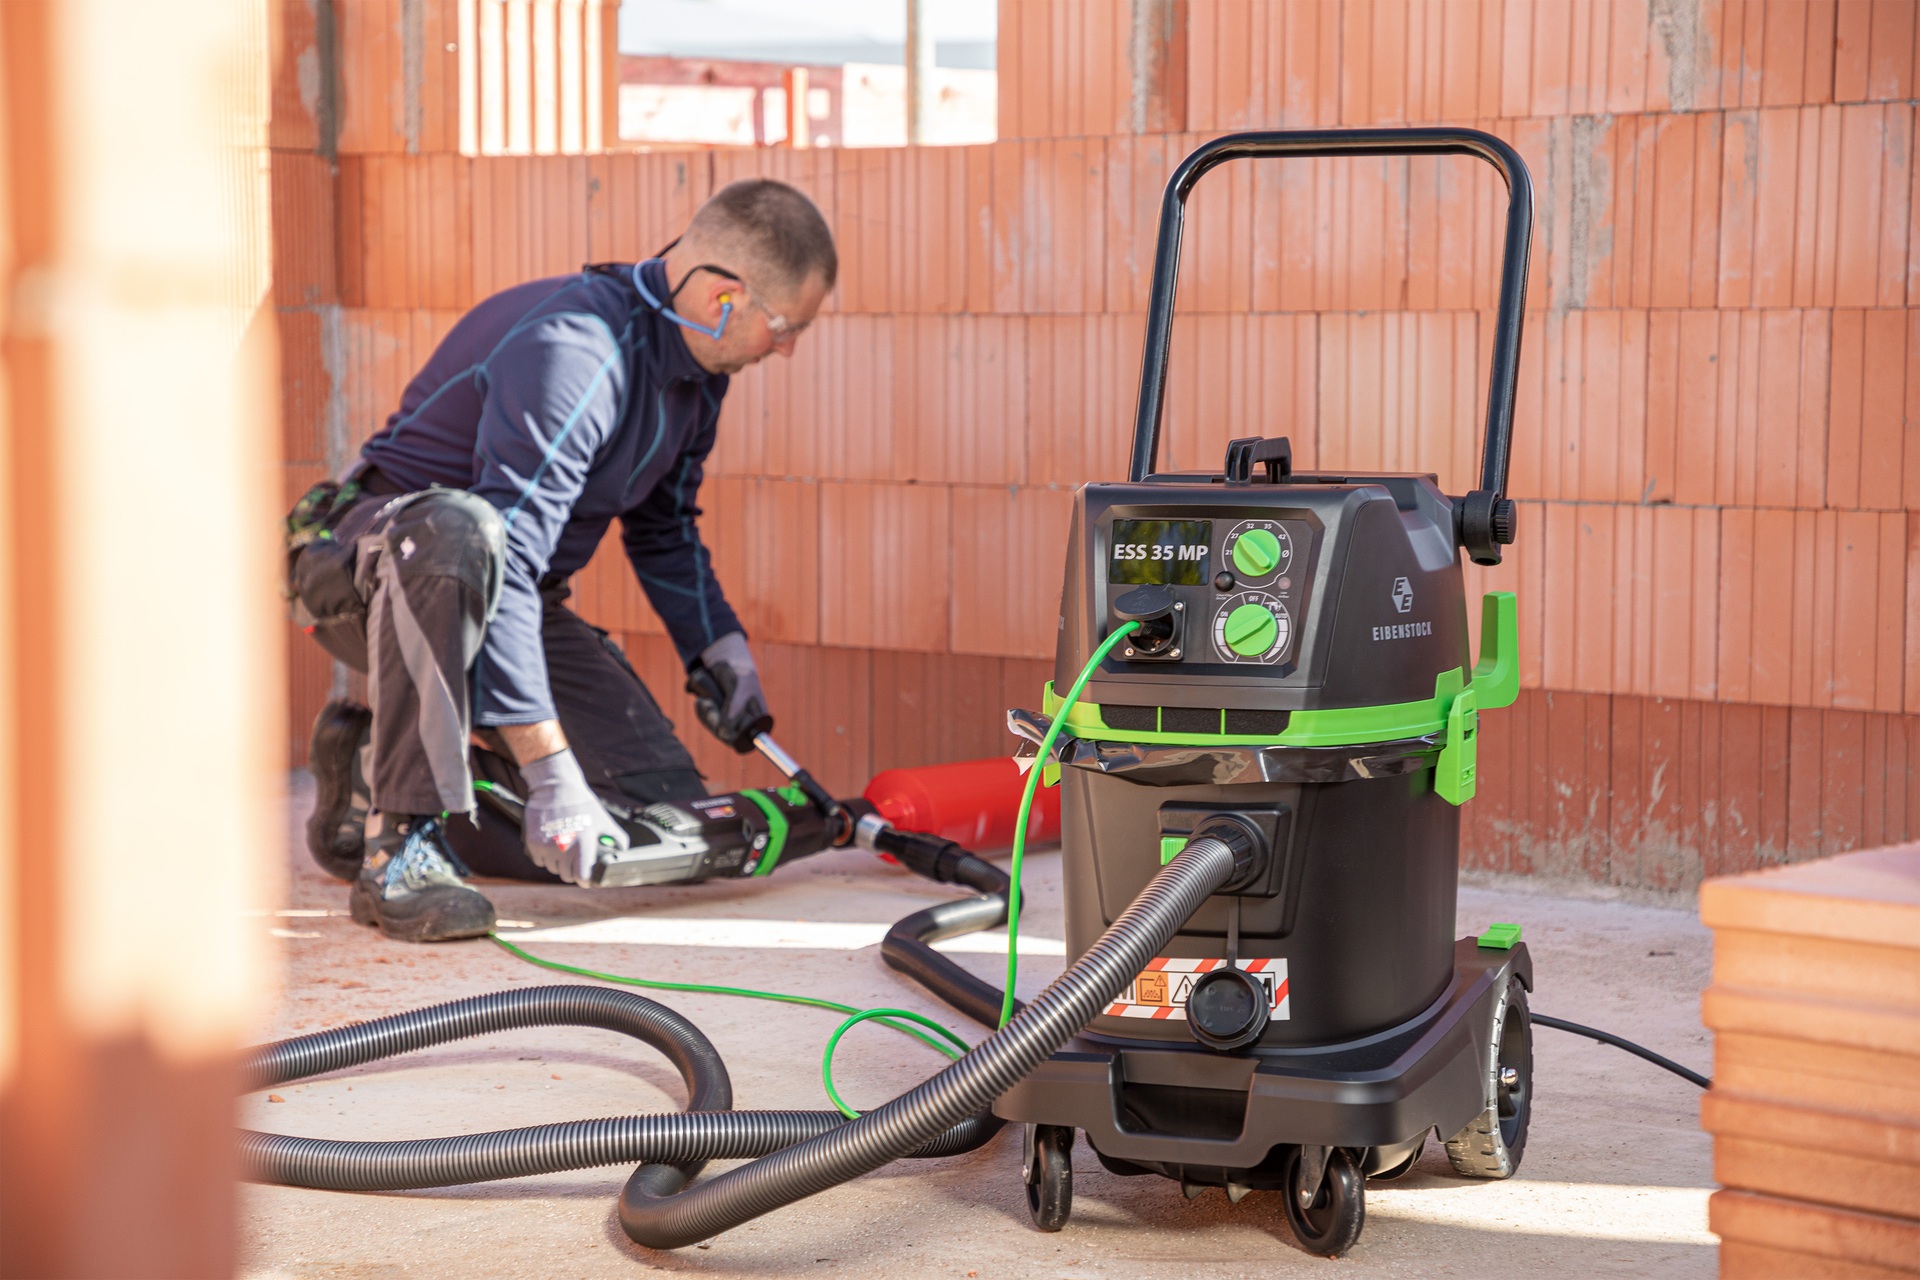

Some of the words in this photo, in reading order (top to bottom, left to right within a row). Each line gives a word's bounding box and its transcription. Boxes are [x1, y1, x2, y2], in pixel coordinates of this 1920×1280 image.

[1113, 544, 1148, 560] ESS
[1150, 544, 1175, 561] 35
[1177, 544, 1209, 561] MP
[1372, 621, 1433, 641] EIBENSTOCK
